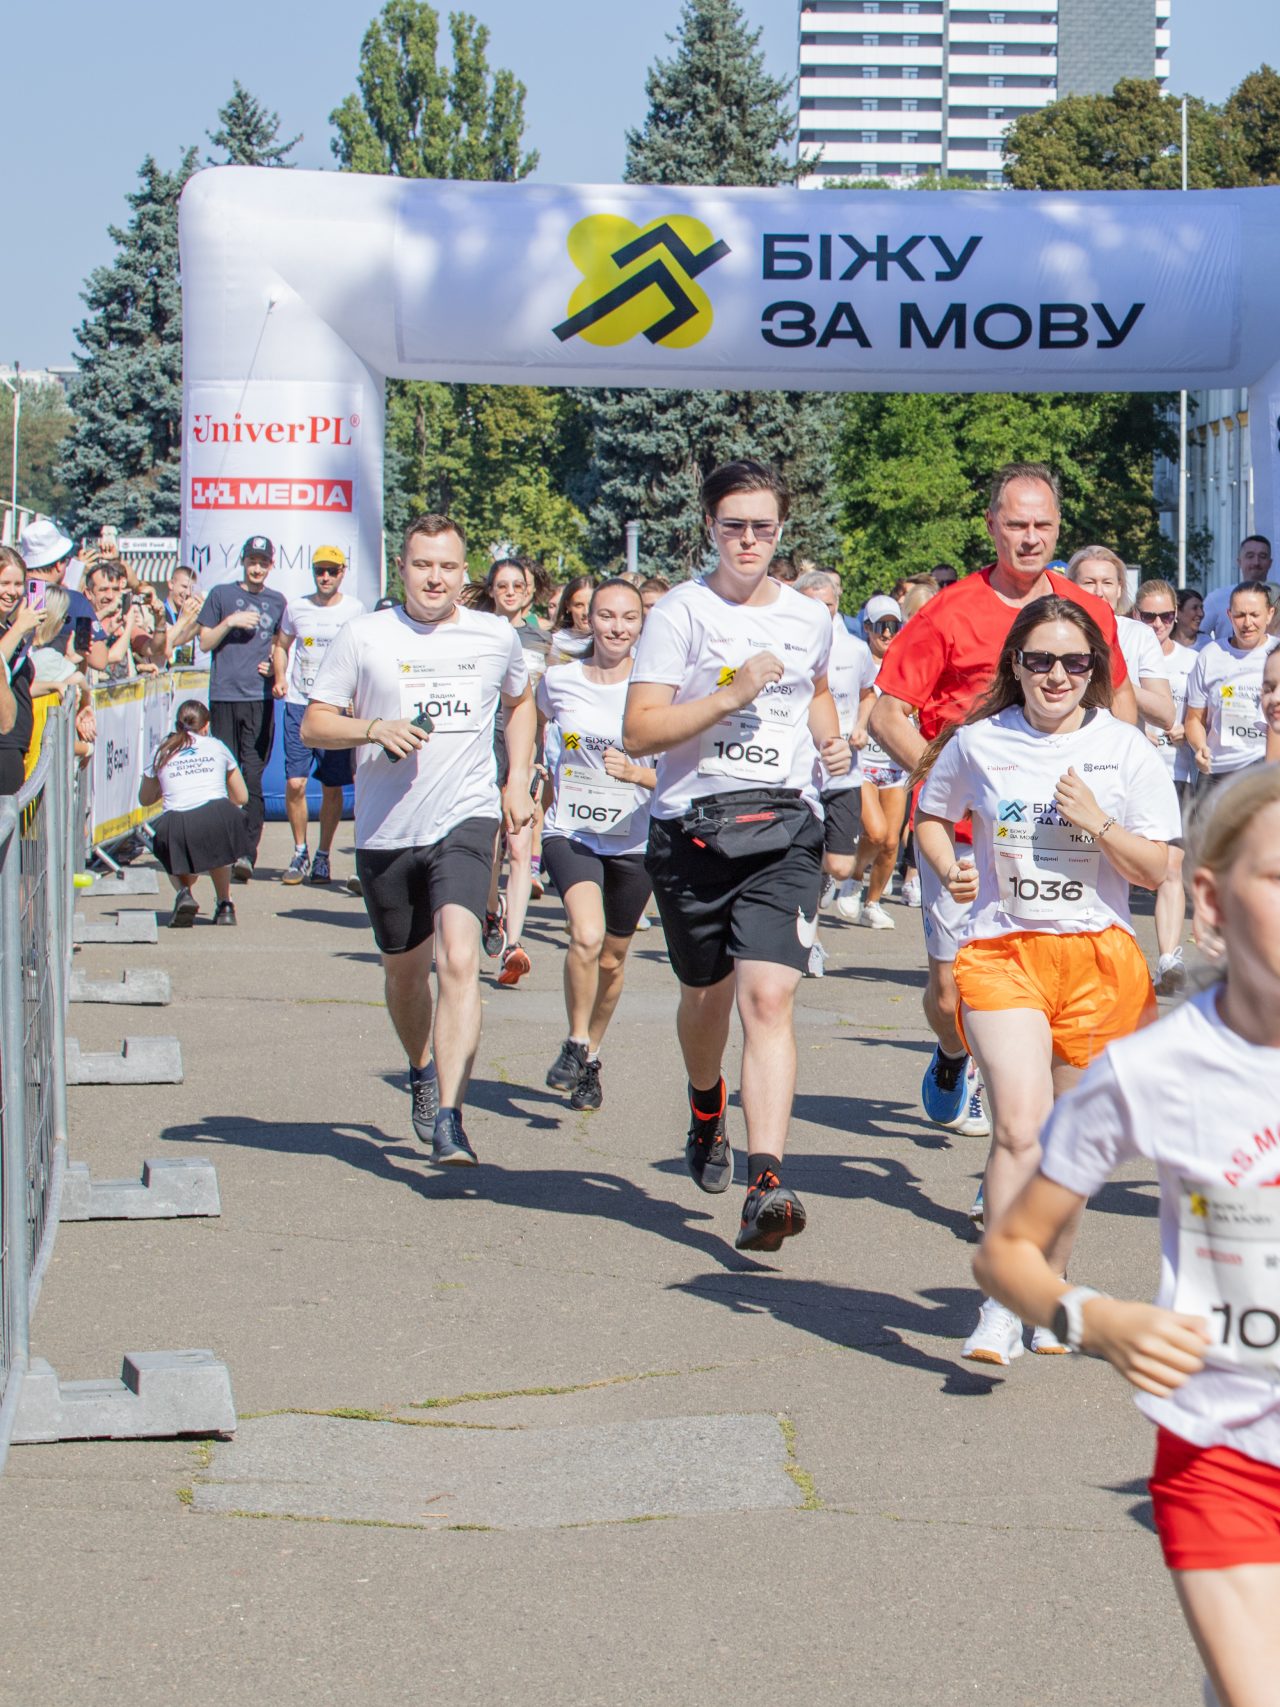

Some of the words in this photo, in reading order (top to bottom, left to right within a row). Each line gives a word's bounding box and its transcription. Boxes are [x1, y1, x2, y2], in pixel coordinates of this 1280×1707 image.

[762, 233, 983, 282] БІЖУ
[761, 301, 872, 349] ЗА
[900, 302, 1146, 350] МОВУ
[193, 482, 236, 505] 1+1
[239, 483, 348, 507] MEDIA
[413, 700, 471, 718] 1014
[585, 736, 615, 746] БІЖУ
[586, 744, 601, 752] ЗА
[714, 740, 780, 767] 1062
[568, 803, 622, 823] 1067
[1009, 876, 1084, 902] 1036
